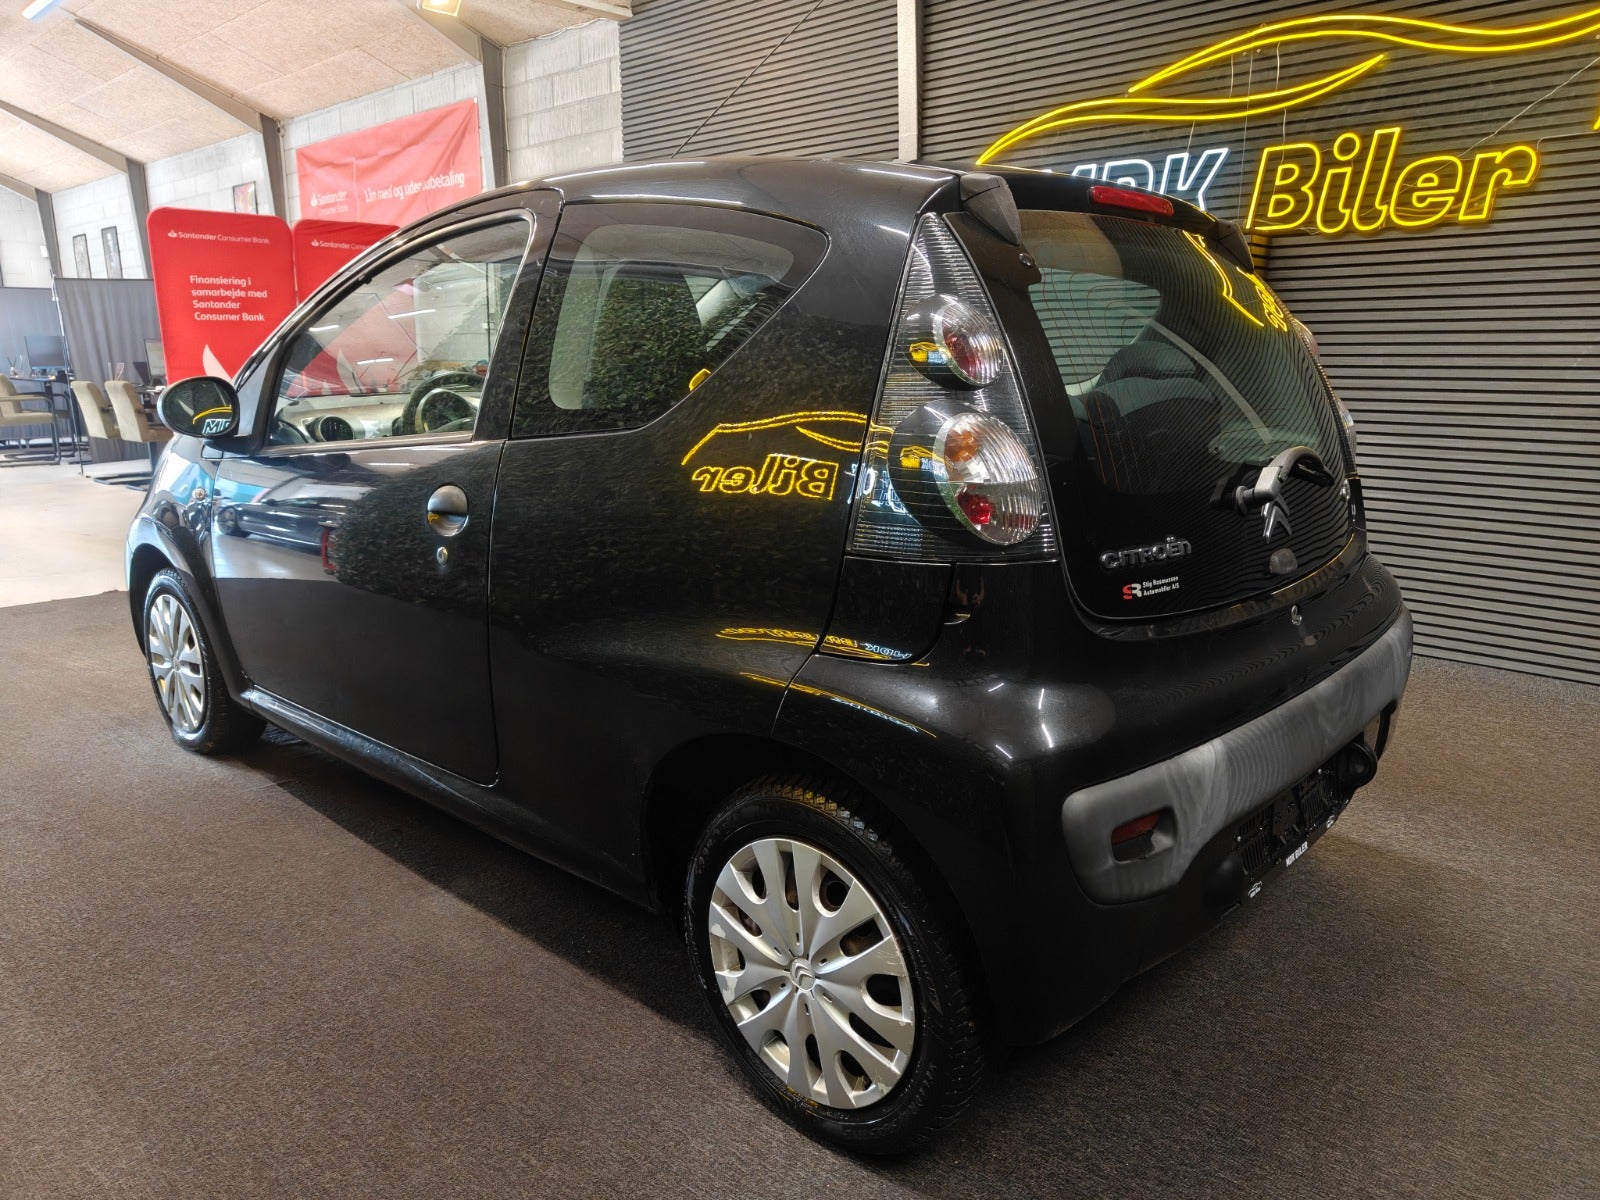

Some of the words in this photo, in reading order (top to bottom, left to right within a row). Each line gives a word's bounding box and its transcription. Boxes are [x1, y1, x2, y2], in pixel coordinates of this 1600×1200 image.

[1246, 126, 1537, 233] Biler
[378, 185, 393, 201] med
[393, 185, 404, 201] og
[178, 231, 217, 240] Santander
[217, 234, 252, 243] Consumer
[252, 236, 270, 244] Bank
[320, 240, 350, 249] Santander
[190, 275, 247, 287] Finansiering
[248, 277, 251, 285] i
[191, 288, 246, 299] samarbejde
[247, 290, 268, 298] med
[192, 300, 241, 309] Santander
[194, 312, 241, 321] Consumer
[242, 312, 265, 321] Bank
